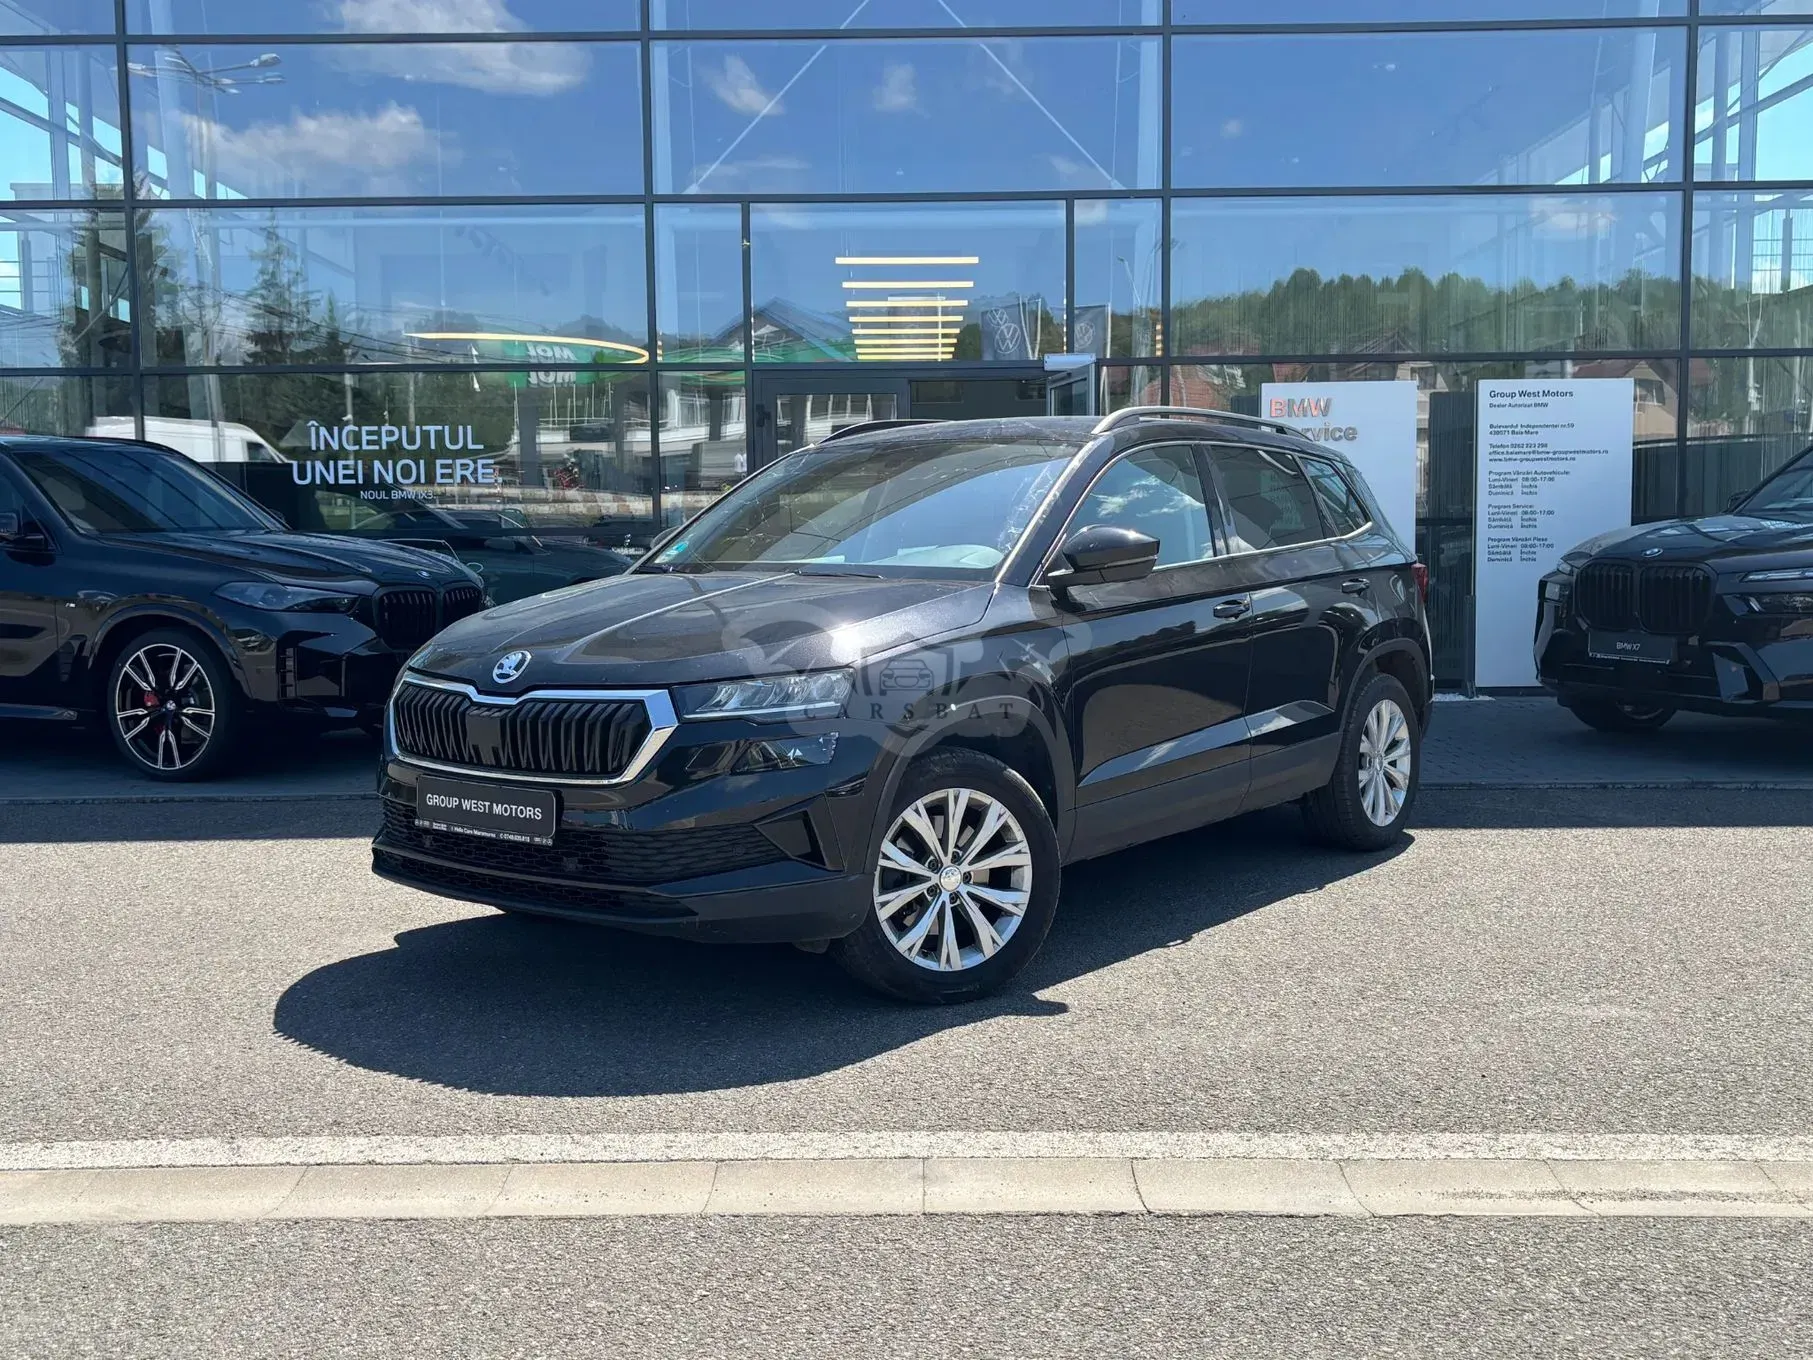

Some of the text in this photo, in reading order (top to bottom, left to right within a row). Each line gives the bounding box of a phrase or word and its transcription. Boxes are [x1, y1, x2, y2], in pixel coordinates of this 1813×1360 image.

[1489, 389, 1574, 399] Group West Motors
[1270, 397, 1333, 417] BMW
[307, 420, 484, 450] ÎNCEPUTUL
[1301, 421, 1358, 441] rvice
[291, 458, 503, 485] UNEI NOI ERE.
[360, 490, 389, 500] NOUL
[391, 490, 416, 500] BMW
[1616, 641, 1640, 651] BMW X7
[426, 793, 542, 820] GROUP WEST MOTORS
